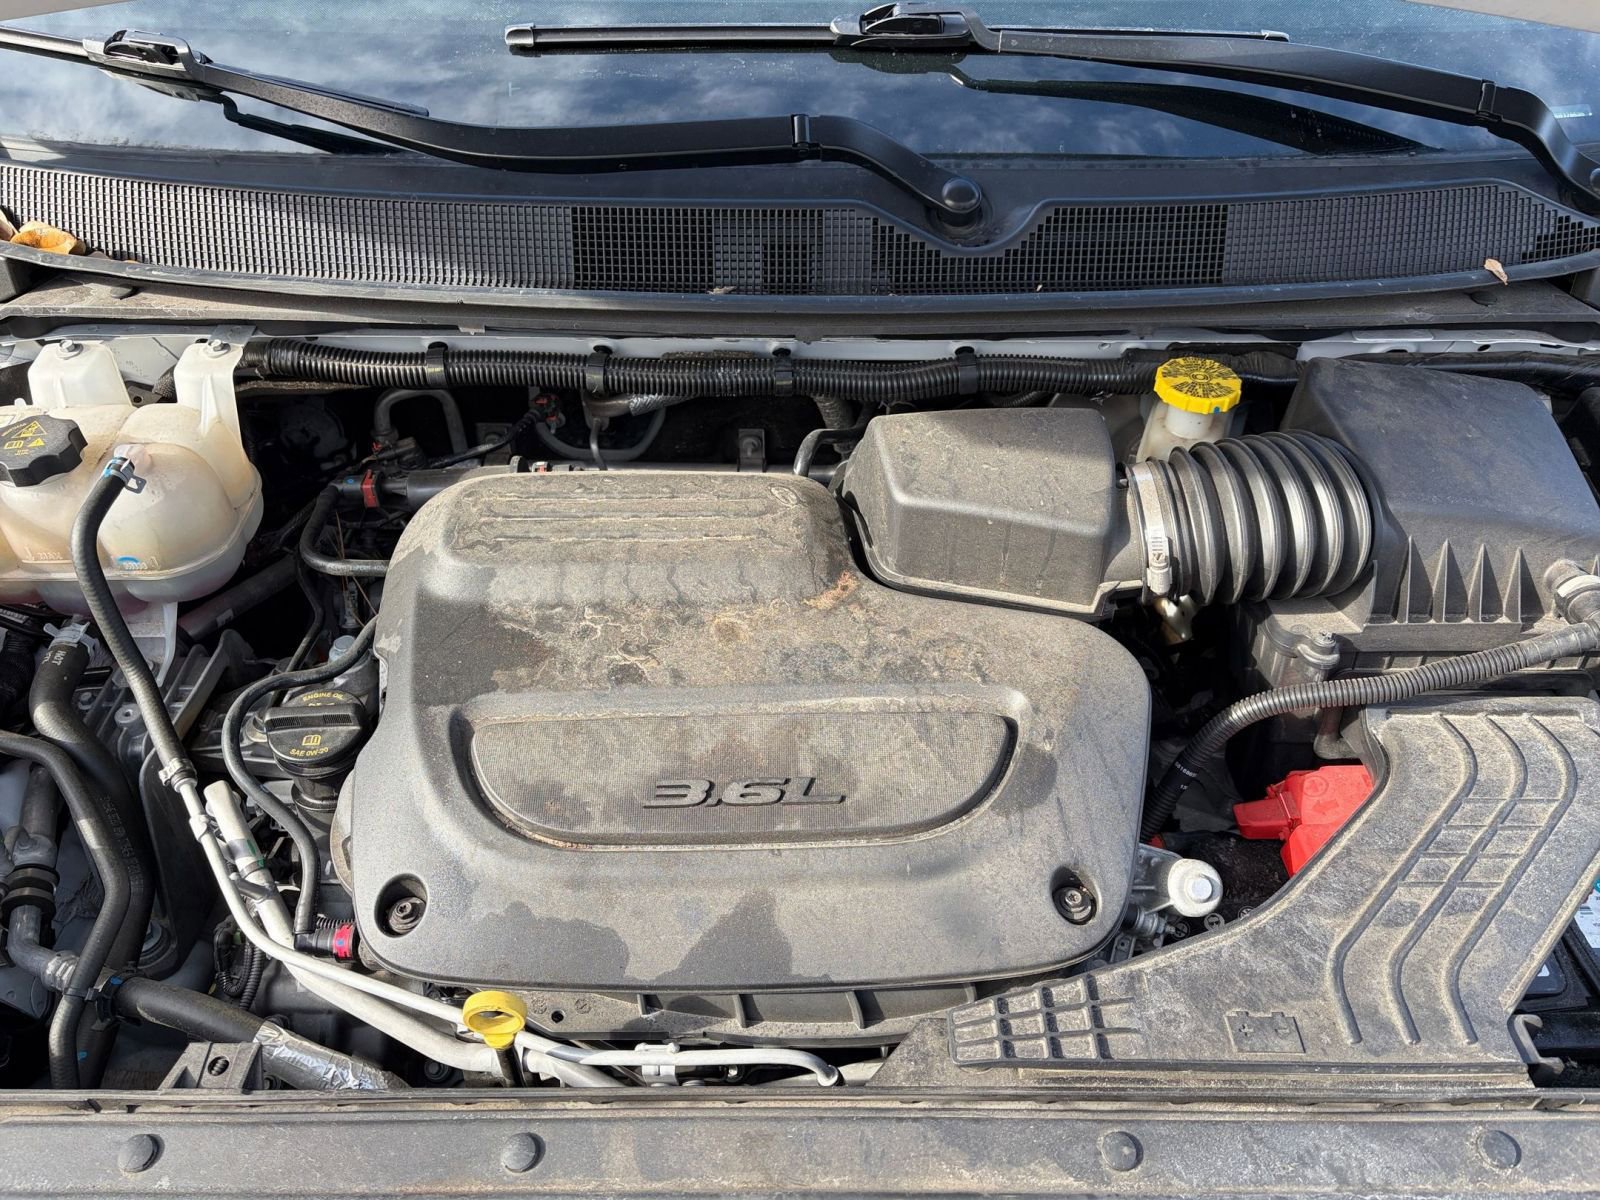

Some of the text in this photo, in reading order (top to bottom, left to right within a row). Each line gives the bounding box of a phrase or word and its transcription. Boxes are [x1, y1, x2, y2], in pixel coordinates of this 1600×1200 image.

[302, 692, 344, 702] ENGINE OIL
[289, 747, 329, 757] SAE 0W-20
[643, 777, 846, 809] 3.6L
